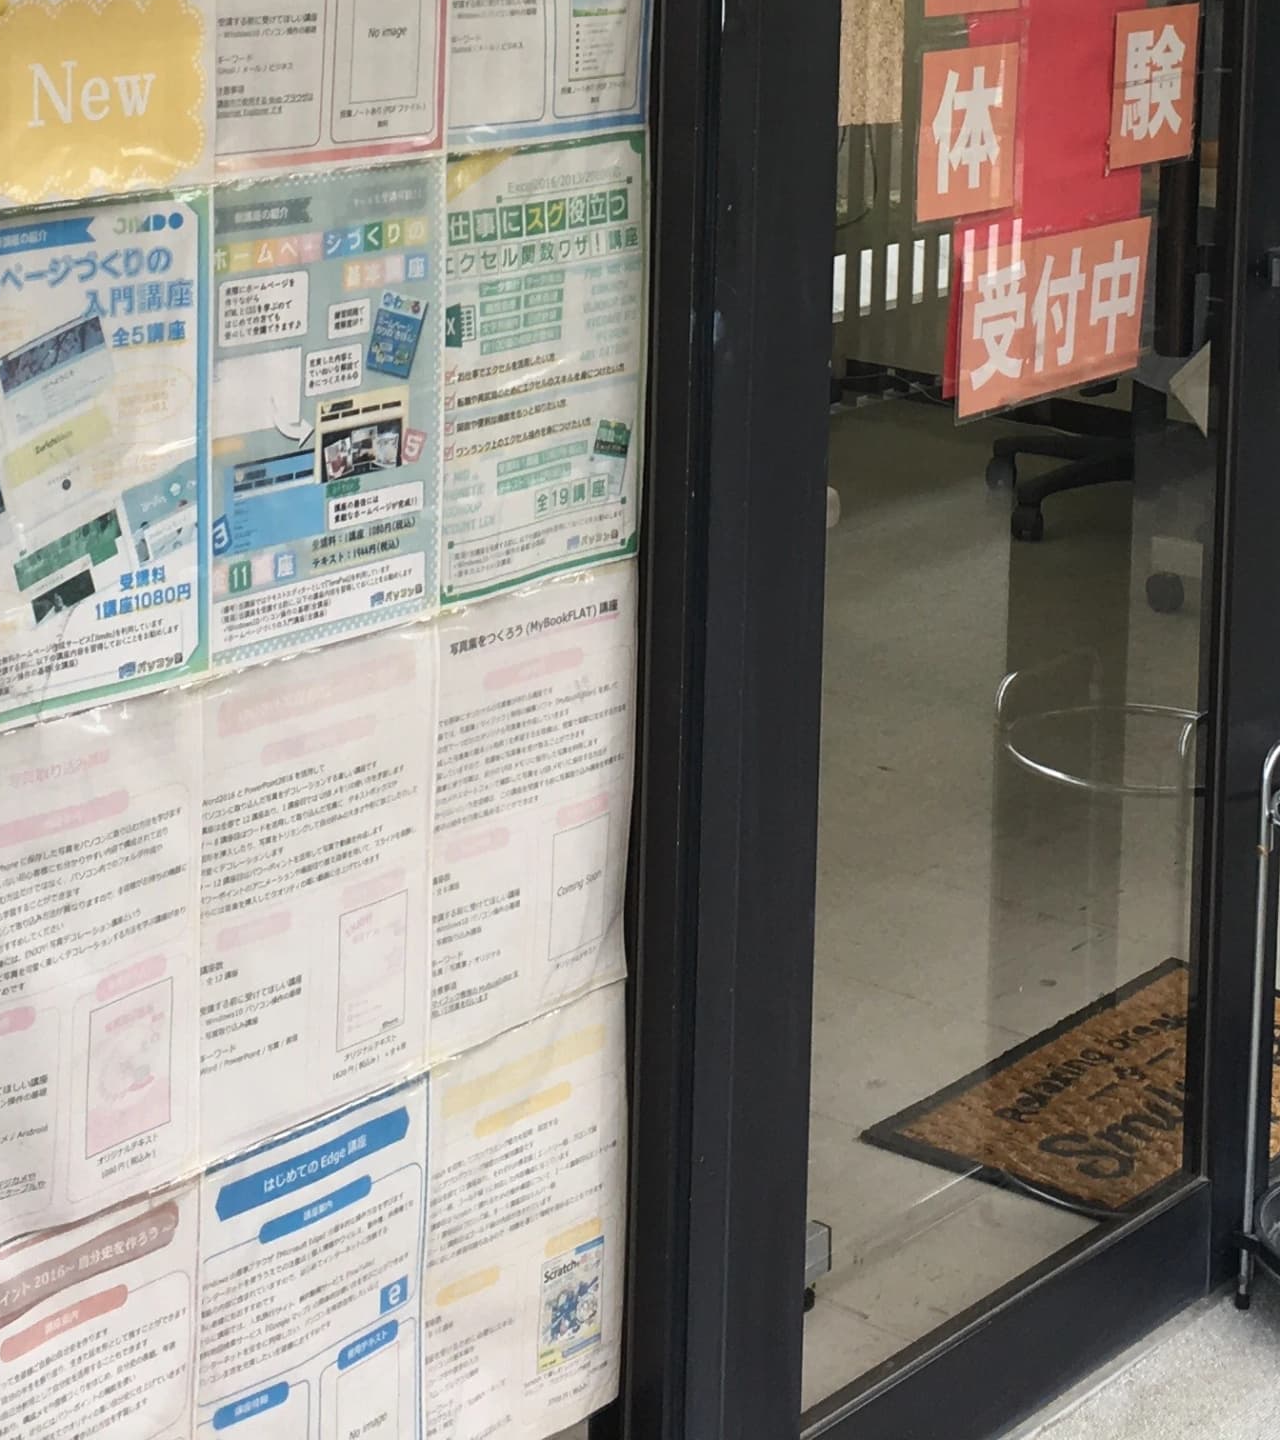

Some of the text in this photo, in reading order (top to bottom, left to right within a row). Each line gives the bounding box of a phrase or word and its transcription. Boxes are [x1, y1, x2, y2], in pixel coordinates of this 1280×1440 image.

[369, 27, 407, 38] No image
[27, 62, 156, 127] New
[932, 25, 1185, 194] 体 験
[450, 194, 625, 240] 仕事にスグ役立つ
[81, 279, 193, 318] 入門講座
[970, 239, 1142, 392] 受付中
[112, 320, 186, 348] 全5講座
[120, 565, 165, 590] 受講料
[96, 583, 192, 620] 1講座1080円
[450, 599, 618, 656] 写真集をつくろう (MyBookFLAT) 講座
[557, 869, 602, 896] Coming Soon
[264, 1134, 367, 1193] はじめての Edge 講座
[544, 1257, 580, 1284] Scratch
